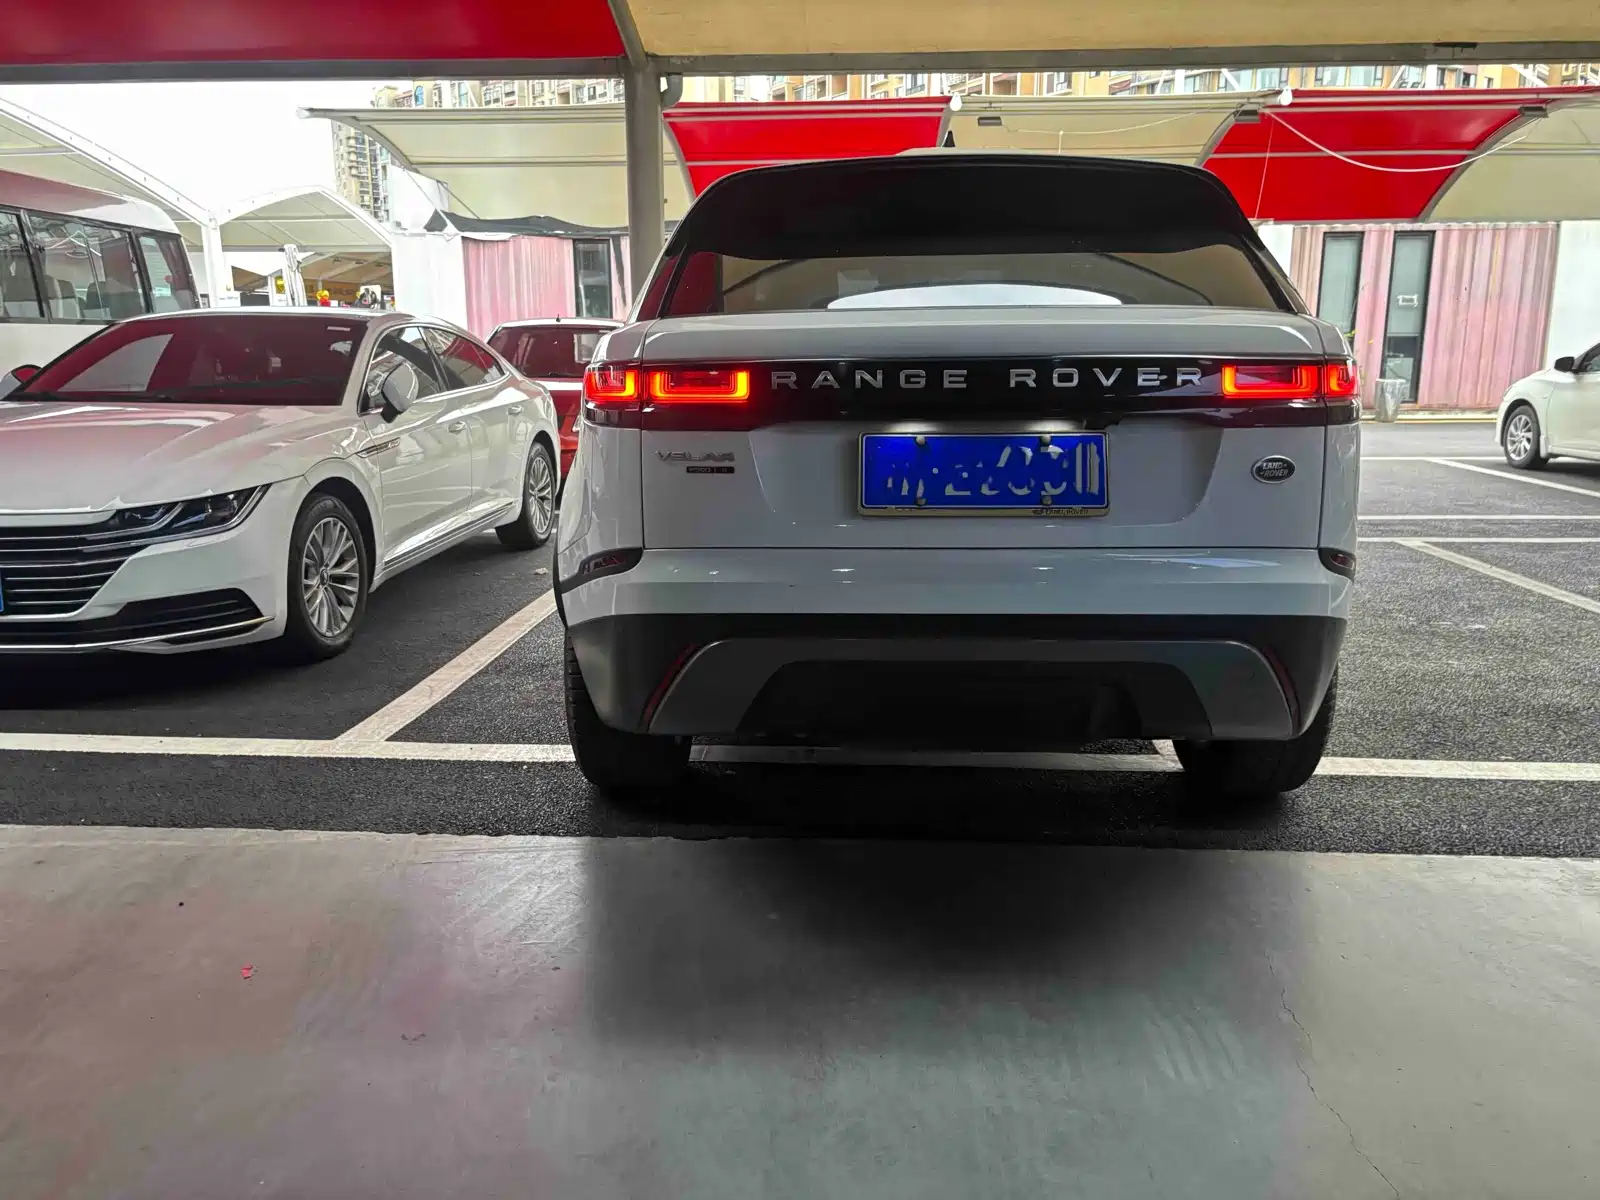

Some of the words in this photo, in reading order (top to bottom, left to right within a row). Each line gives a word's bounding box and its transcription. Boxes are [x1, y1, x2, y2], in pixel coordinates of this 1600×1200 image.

[771, 369, 968, 390] RANGE
[1009, 367, 1203, 388] ROVER
[1262, 461, 1283, 470] LAND
[1263, 468, 1289, 477] ROVER
